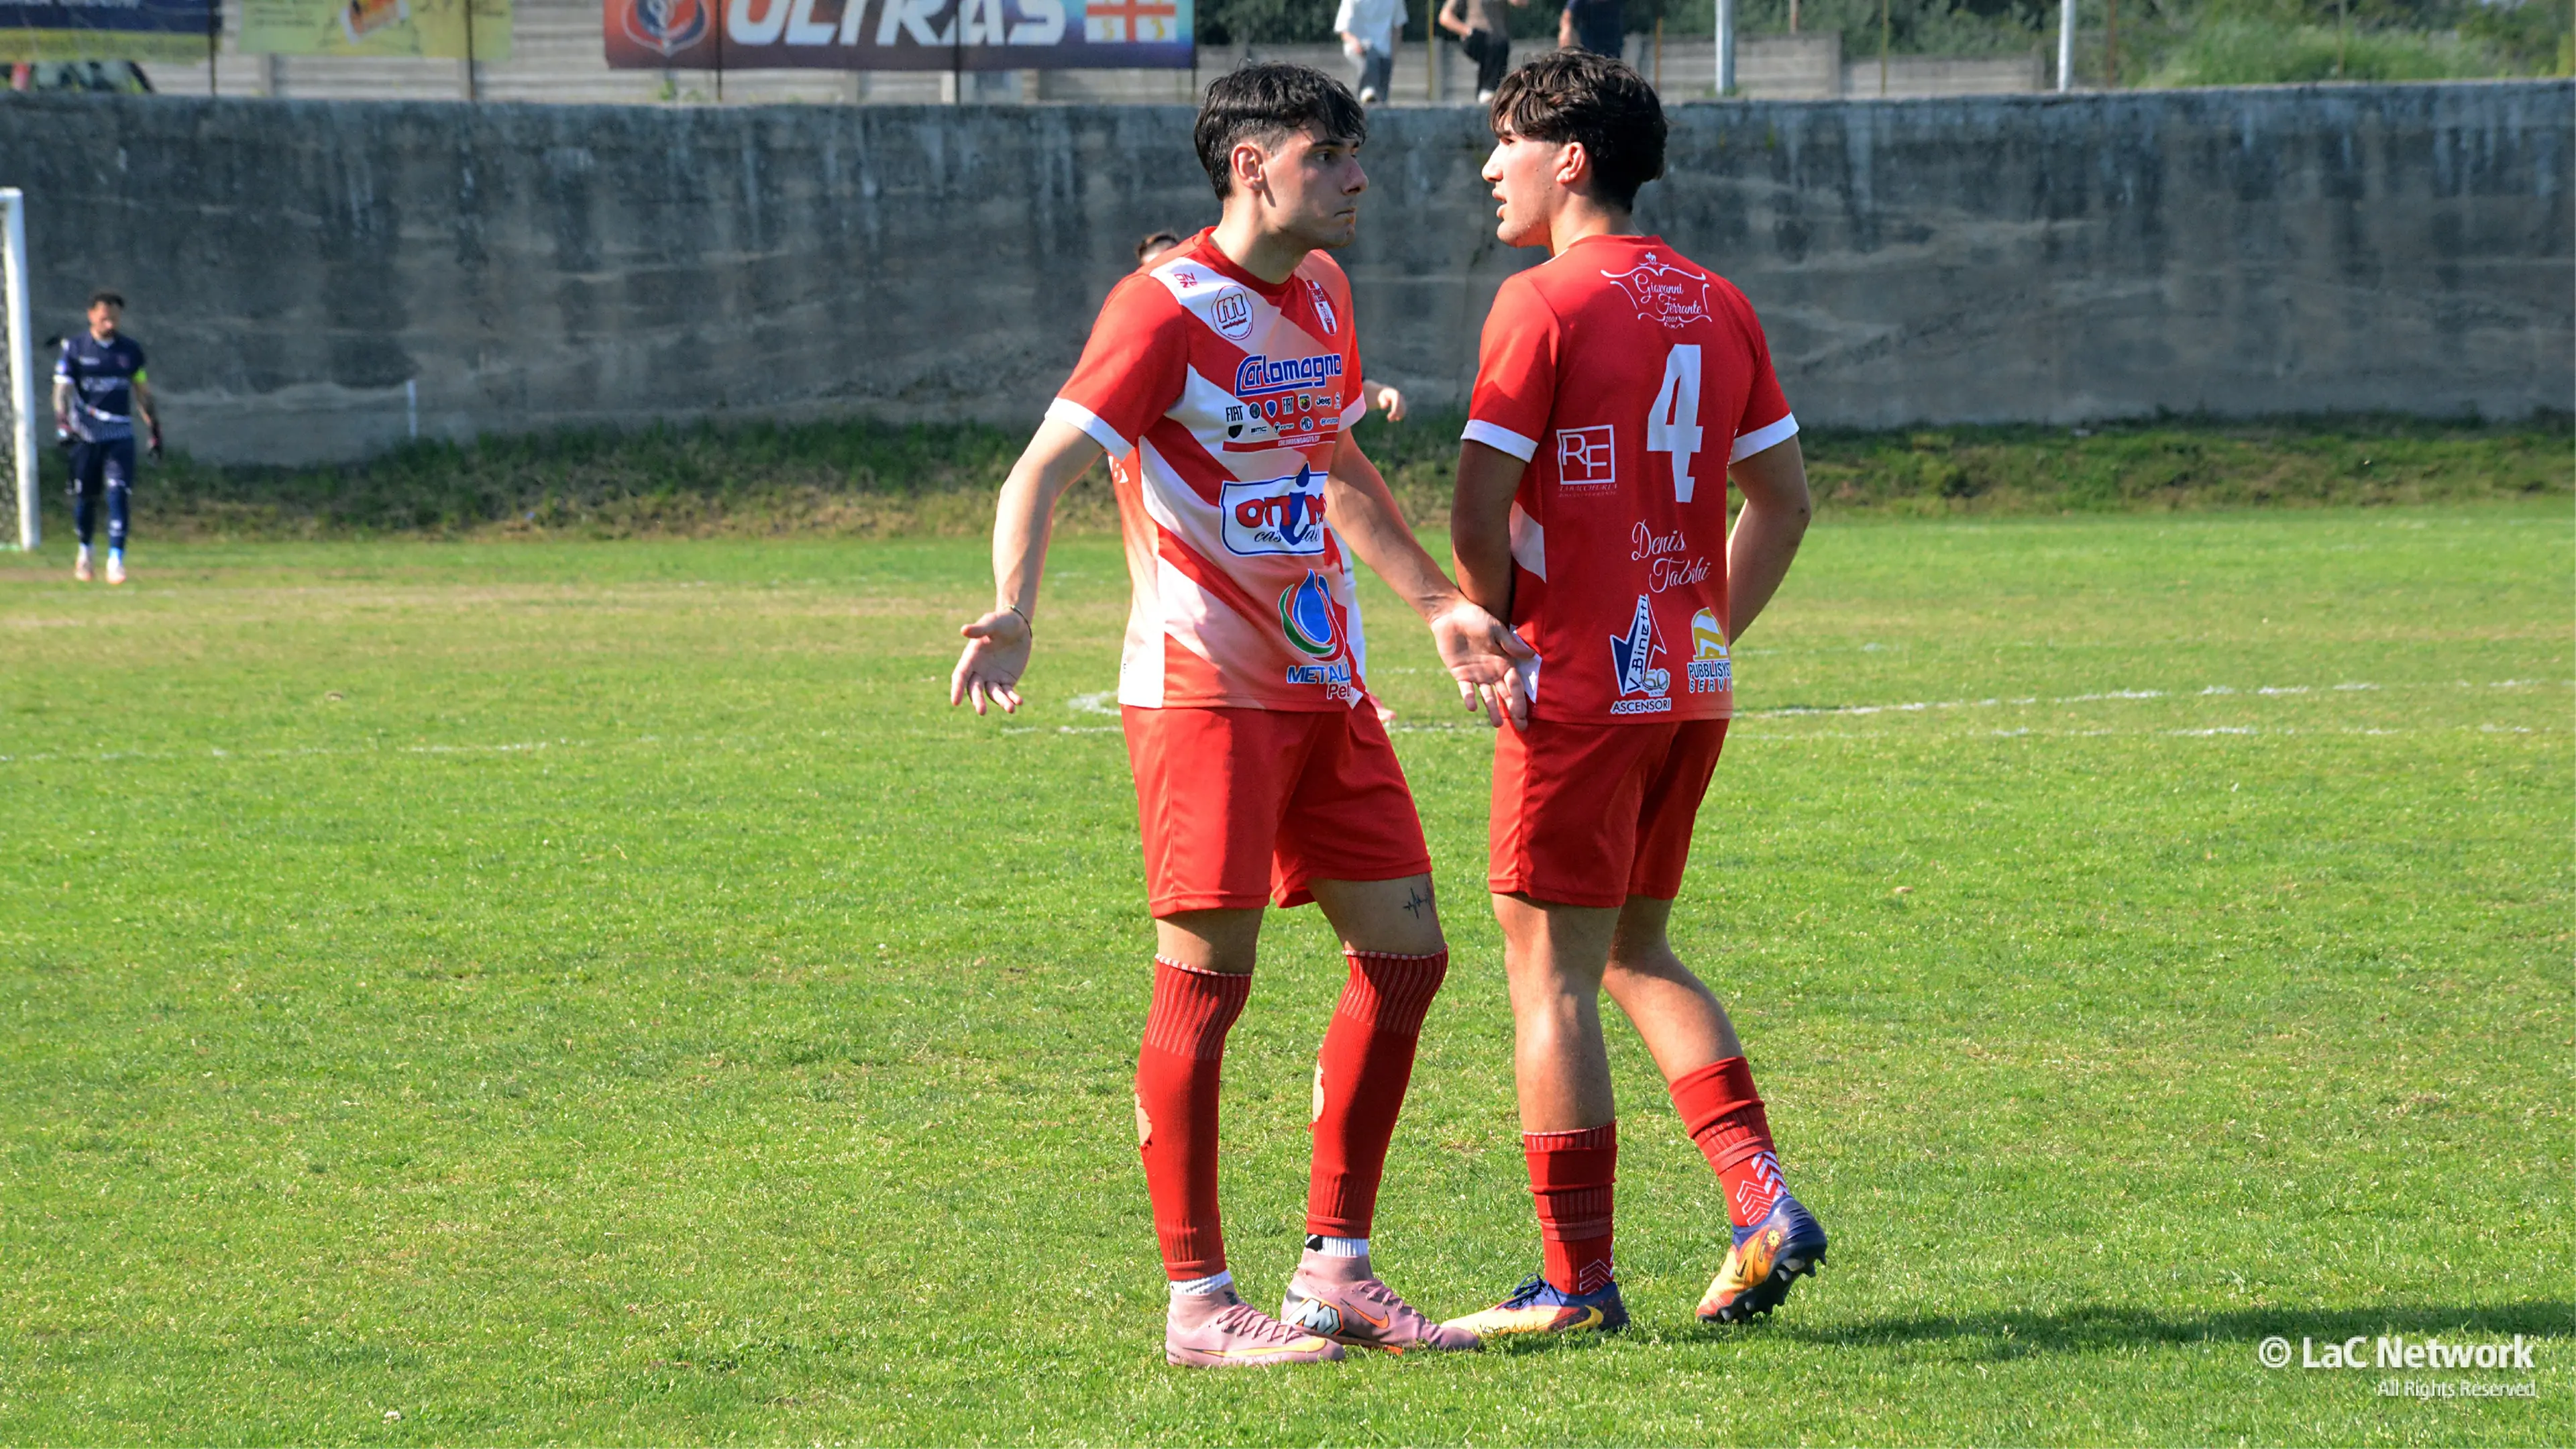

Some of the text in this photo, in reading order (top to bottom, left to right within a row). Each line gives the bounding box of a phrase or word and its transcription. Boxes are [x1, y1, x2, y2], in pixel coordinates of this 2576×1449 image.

[1631, 273, 1684, 303] Giovanni
[1656, 293, 1702, 315] Ferrante
[1236, 354, 1342, 396] Carlomagno
[1226, 405, 1243, 421] FIAT
[1283, 397, 1293, 414] FIAT
[1316, 396, 1332, 407] Jeep
[1647, 344, 1703, 502] 4
[1562, 434, 1609, 478] RF
[1631, 519, 1686, 561] Denis
[1612, 700, 1670, 712] ASCENSORI
